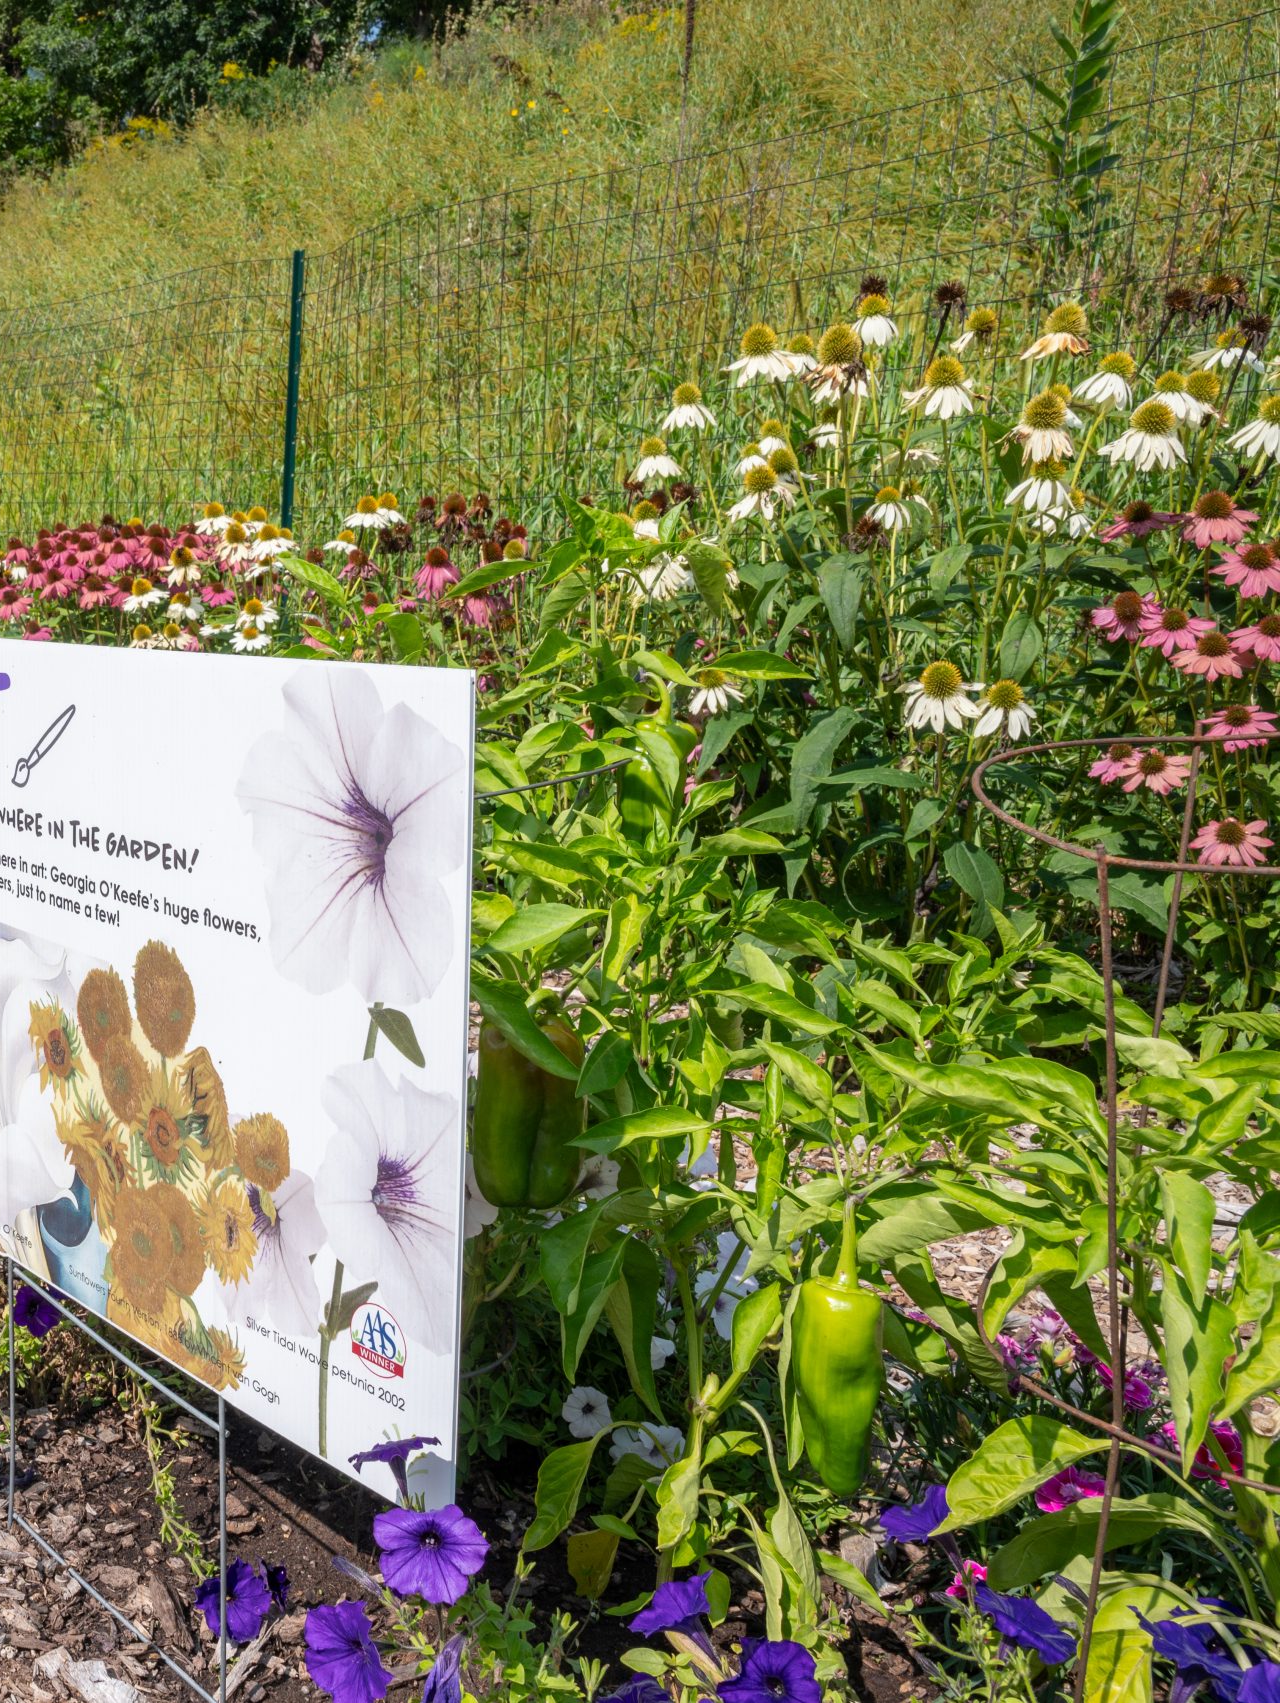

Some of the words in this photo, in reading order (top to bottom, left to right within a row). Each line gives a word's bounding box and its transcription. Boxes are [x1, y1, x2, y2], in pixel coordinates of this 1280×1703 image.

[48, 819, 64, 839] IN
[69, 820, 100, 852] THE
[106, 832, 200, 874] GARDEN!
[16, 879, 34, 899] just
[36, 885, 47, 903] to
[49, 893, 81, 915] name
[84, 904, 93, 919] a
[95, 903, 120, 928] few!
[19, 855, 28, 874] in
[31, 862, 47, 879] art:
[50, 866, 96, 894] Georgia
[100, 880, 160, 912] O'Keefe's
[163, 896, 200, 925] huge
[203, 907, 261, 943] flowers,
[68, 1264, 106, 1296] Sunflowers
[232, 1369, 250, 1387] van
[252, 1380, 281, 1405] Gogh
[359, 1310, 397, 1360] AAS
[360, 1346, 396, 1373] WINNER
[246, 1316, 271, 1339] Silver
[272, 1329, 296, 1353] Tidal
[298, 1343, 328, 1370] Wave
[331, 1364, 376, 1395] petunia
[378, 1386, 406, 1412] 2002
